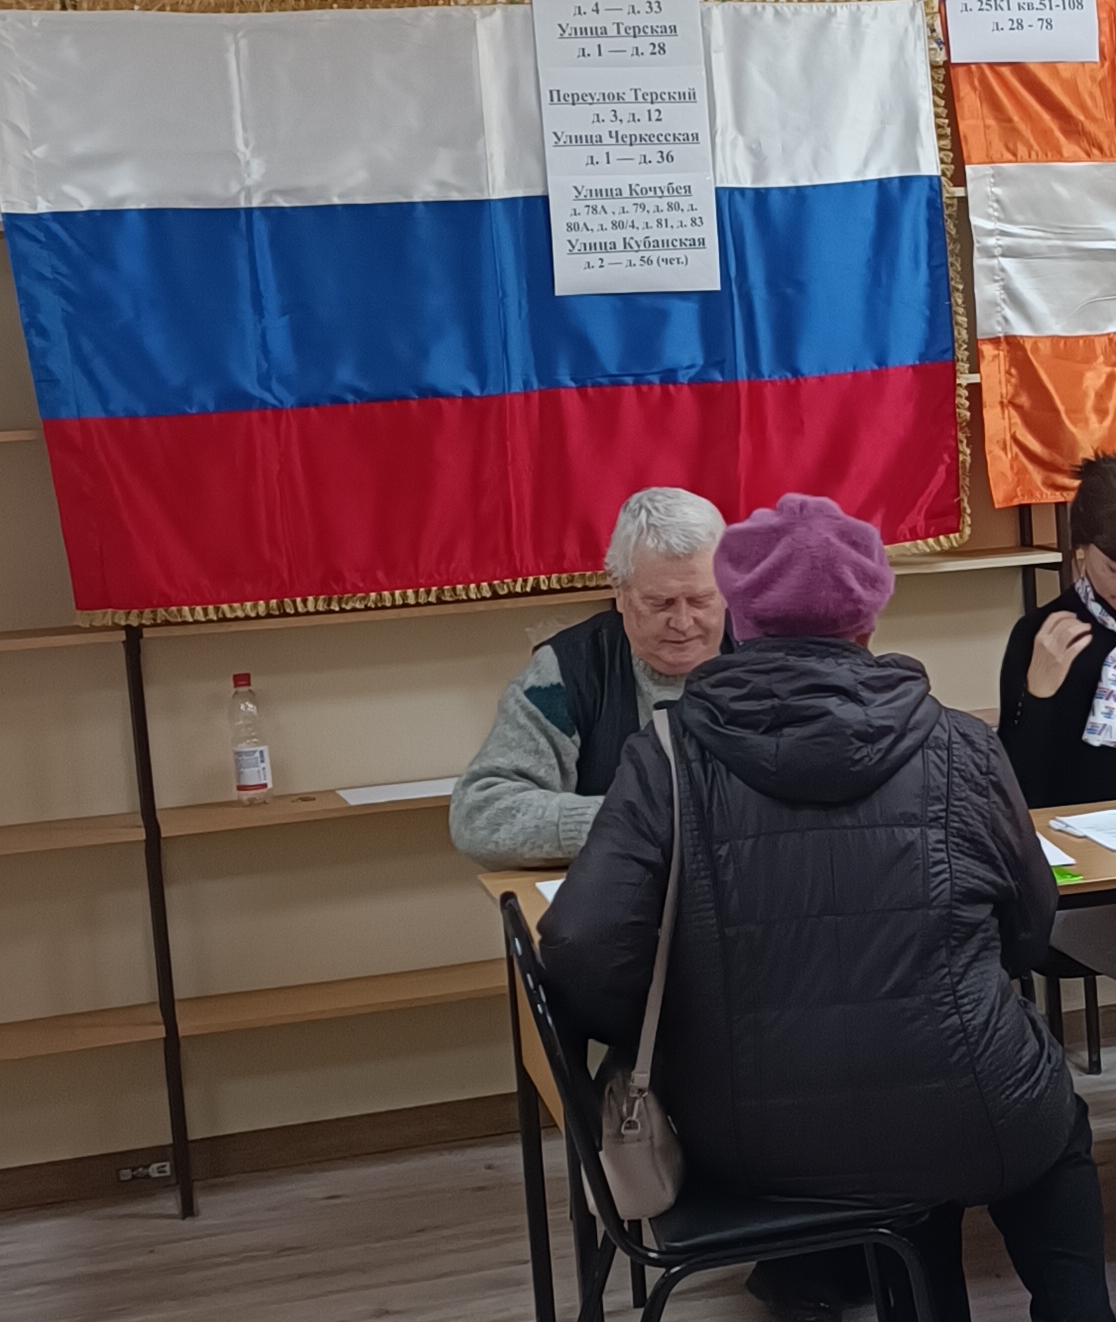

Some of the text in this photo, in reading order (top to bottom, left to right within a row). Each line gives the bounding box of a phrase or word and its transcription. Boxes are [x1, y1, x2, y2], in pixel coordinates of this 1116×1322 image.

[573, 4, 587, 16] д.
[591, 2, 600, 15] 4
[627, 4, 641, 15] д.
[645, 0, 663, 14] 33
[960, 2, 973, 13] д.
[557, 22, 678, 38] Улица Терская
[991, 21, 1004, 33] д.
[1008, 18, 1024, 31] 28
[1037, 18, 1053, 31] 78
[577, 46, 591, 58] д.
[596, 44, 602, 57] 1
[631, 46, 645, 58] д.
[649, 42, 667, 56] 28
[549, 87, 697, 105] Переулок Терский
[592, 108, 663, 124] д. 3, д. 12
[552, 130, 700, 146] Улица Черкесская
[585, 155, 599, 167] д.
[605, 151, 611, 165] 1
[638, 154, 652, 165] д.
[656, 150, 674, 164] 36
[572, 182, 692, 199] Улица Кочубея
[569, 207, 581, 217] д.
[618, 205, 629, 215] д.
[632, 202, 650, 215] 79,
[652, 204, 664, 214] д.
[666, 201, 684, 213] 80,
[687, 202, 698, 213] д.
[596, 223, 608, 233] д.
[610, 219, 640, 232] 80/4,
[642, 220, 653, 231] д.
[656, 218, 674, 230] 81,
[676, 219, 687, 229] д.
[690, 216, 704, 228] 83
[566, 235, 706, 254] Улица Кубанская
[583, 260, 595, 270] д.
[598, 257, 605, 268] 2
[625, 258, 637, 268] д.
[639, 255, 653, 267] 56
[656, 254, 689, 268] (чет.)
